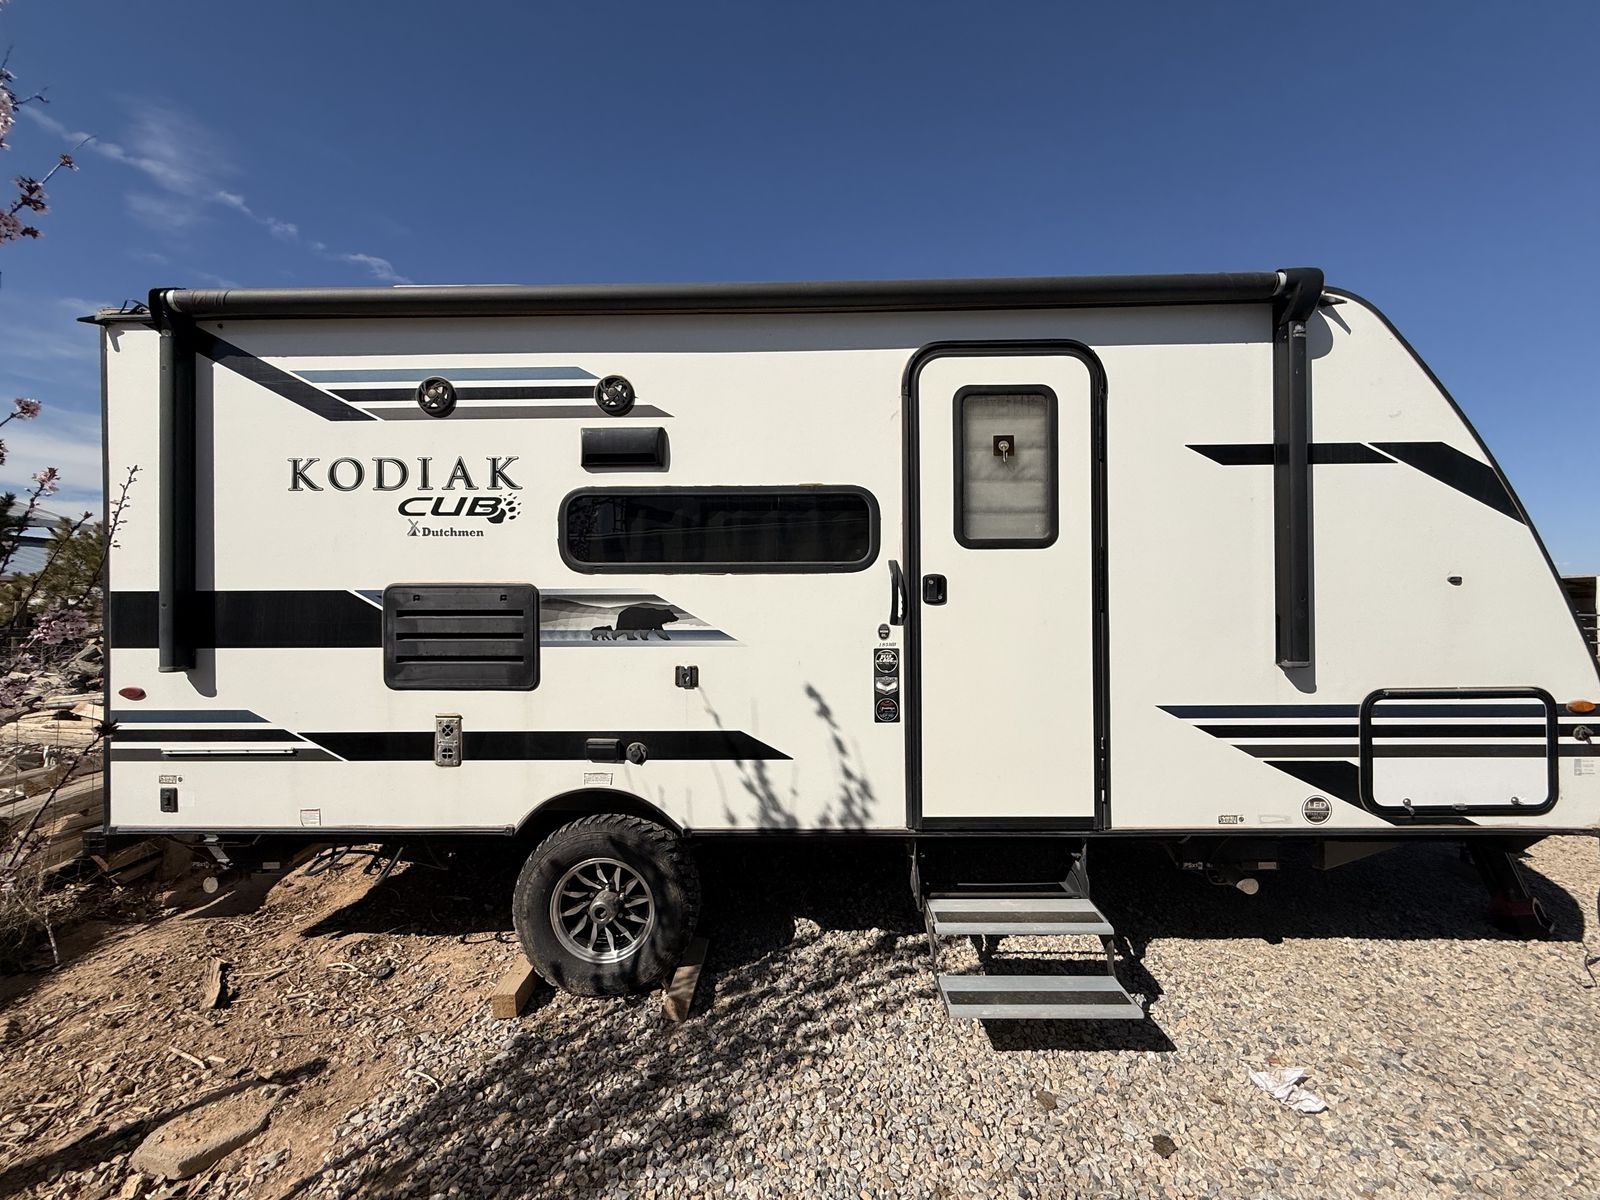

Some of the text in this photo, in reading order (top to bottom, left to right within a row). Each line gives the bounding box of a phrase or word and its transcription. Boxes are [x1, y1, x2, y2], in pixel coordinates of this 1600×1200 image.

[287, 456, 523, 491] KODIAK
[397, 496, 502, 517] CUB
[422, 526, 484, 537] Dutchmen
[1307, 801, 1327, 809] LED
